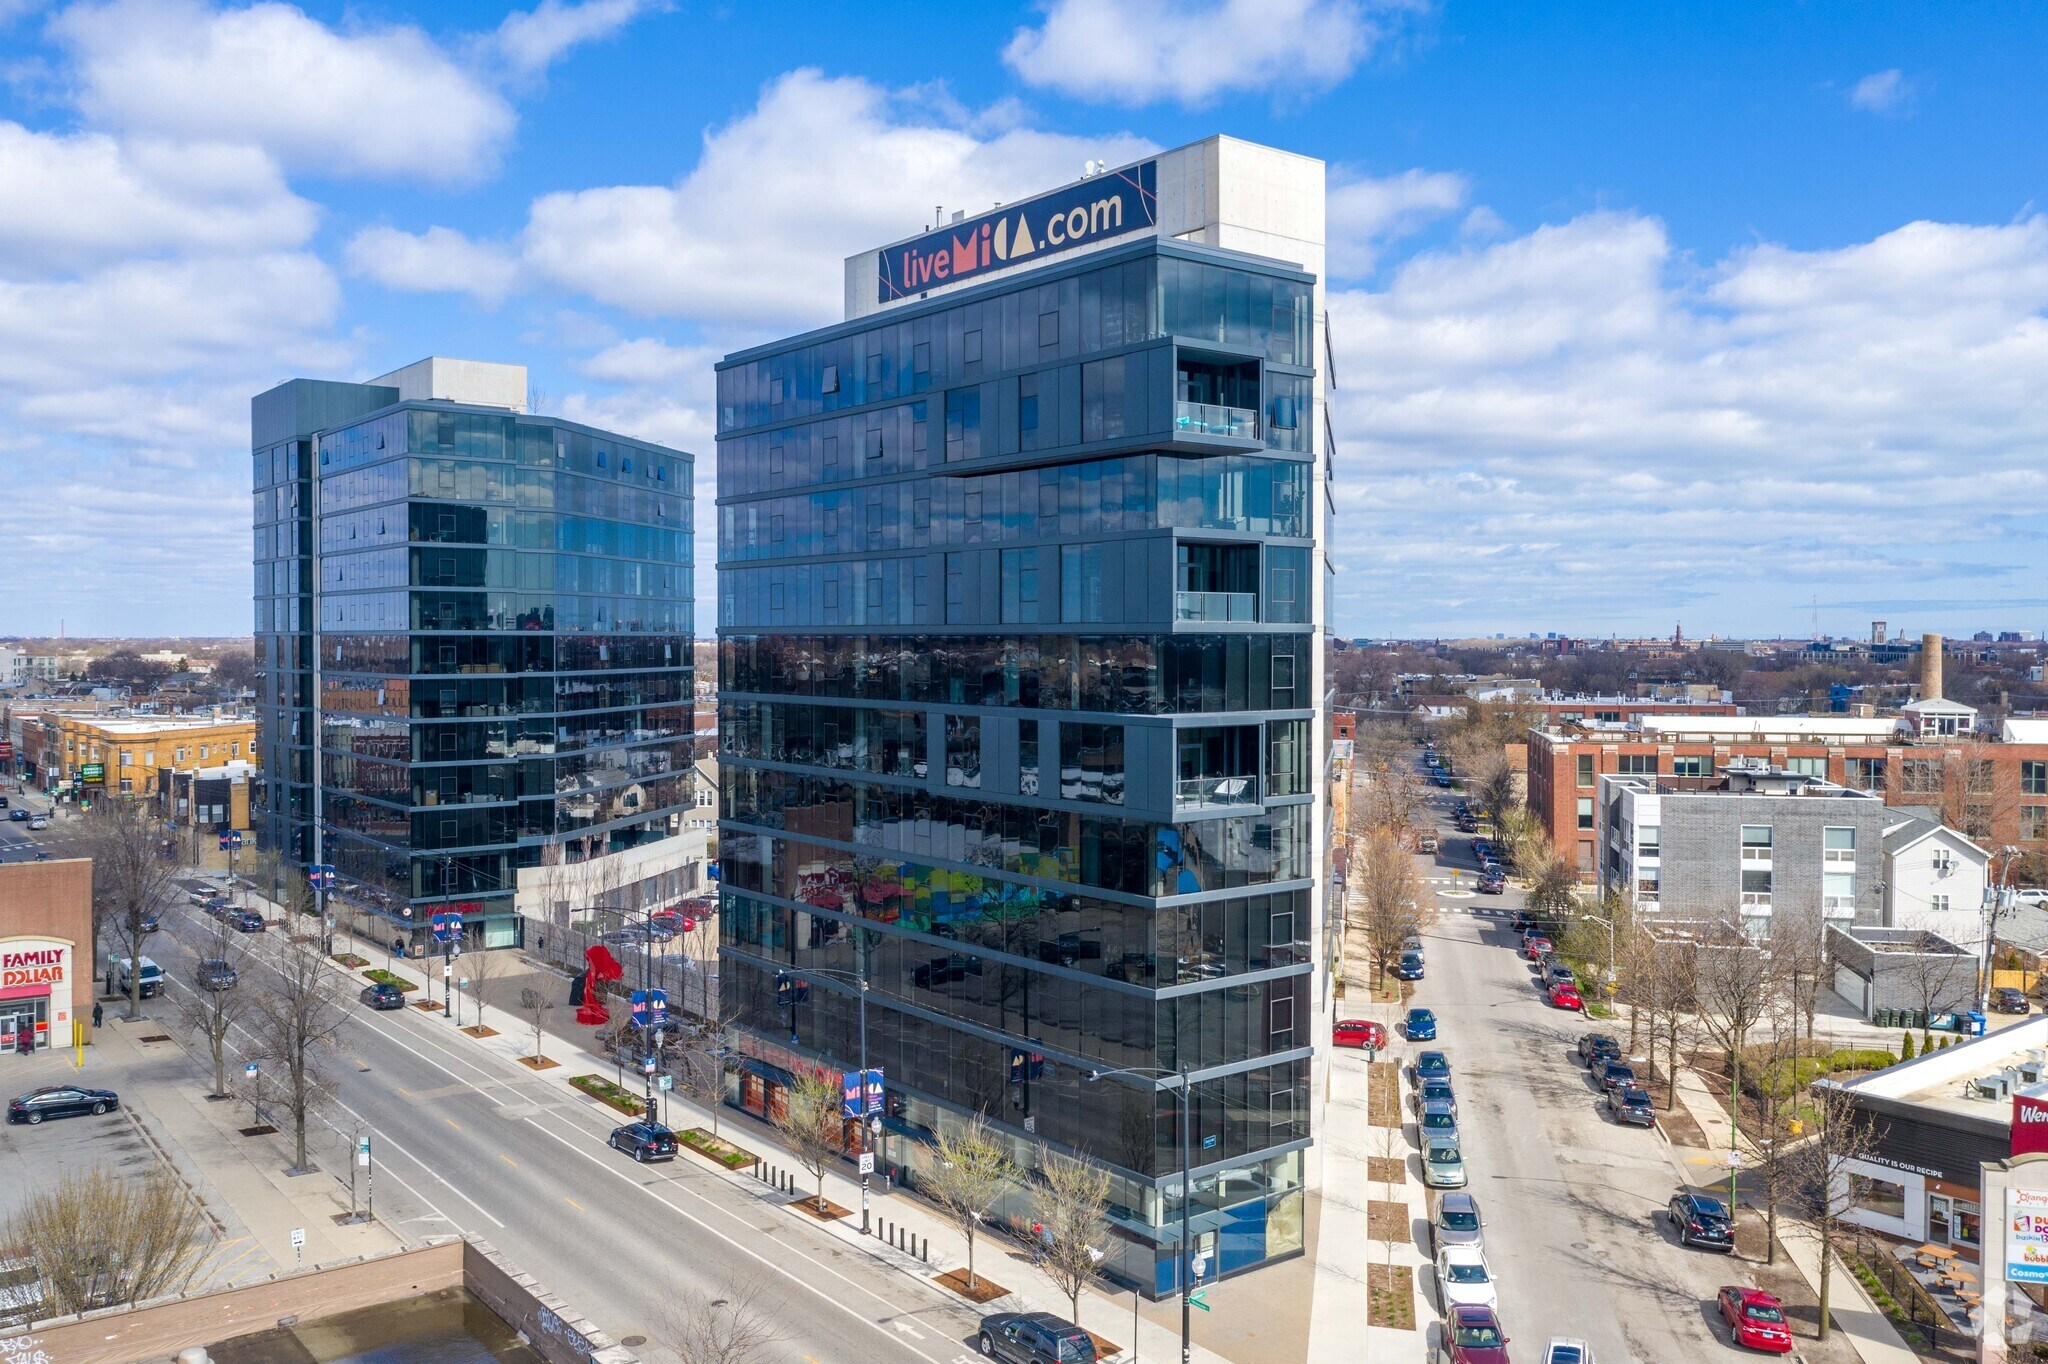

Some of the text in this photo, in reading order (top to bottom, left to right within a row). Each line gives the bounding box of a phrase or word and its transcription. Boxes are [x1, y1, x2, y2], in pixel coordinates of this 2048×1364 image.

[3, 949, 64, 968] FAMILY
[3, 966, 63, 986] DOLLAR
[862, 1162, 872, 1170] 20
[1891, 1160, 1898, 1168] IS
[1899, 1162, 1915, 1172] OUR
[1916, 1166, 1943, 1179] RECIPE
